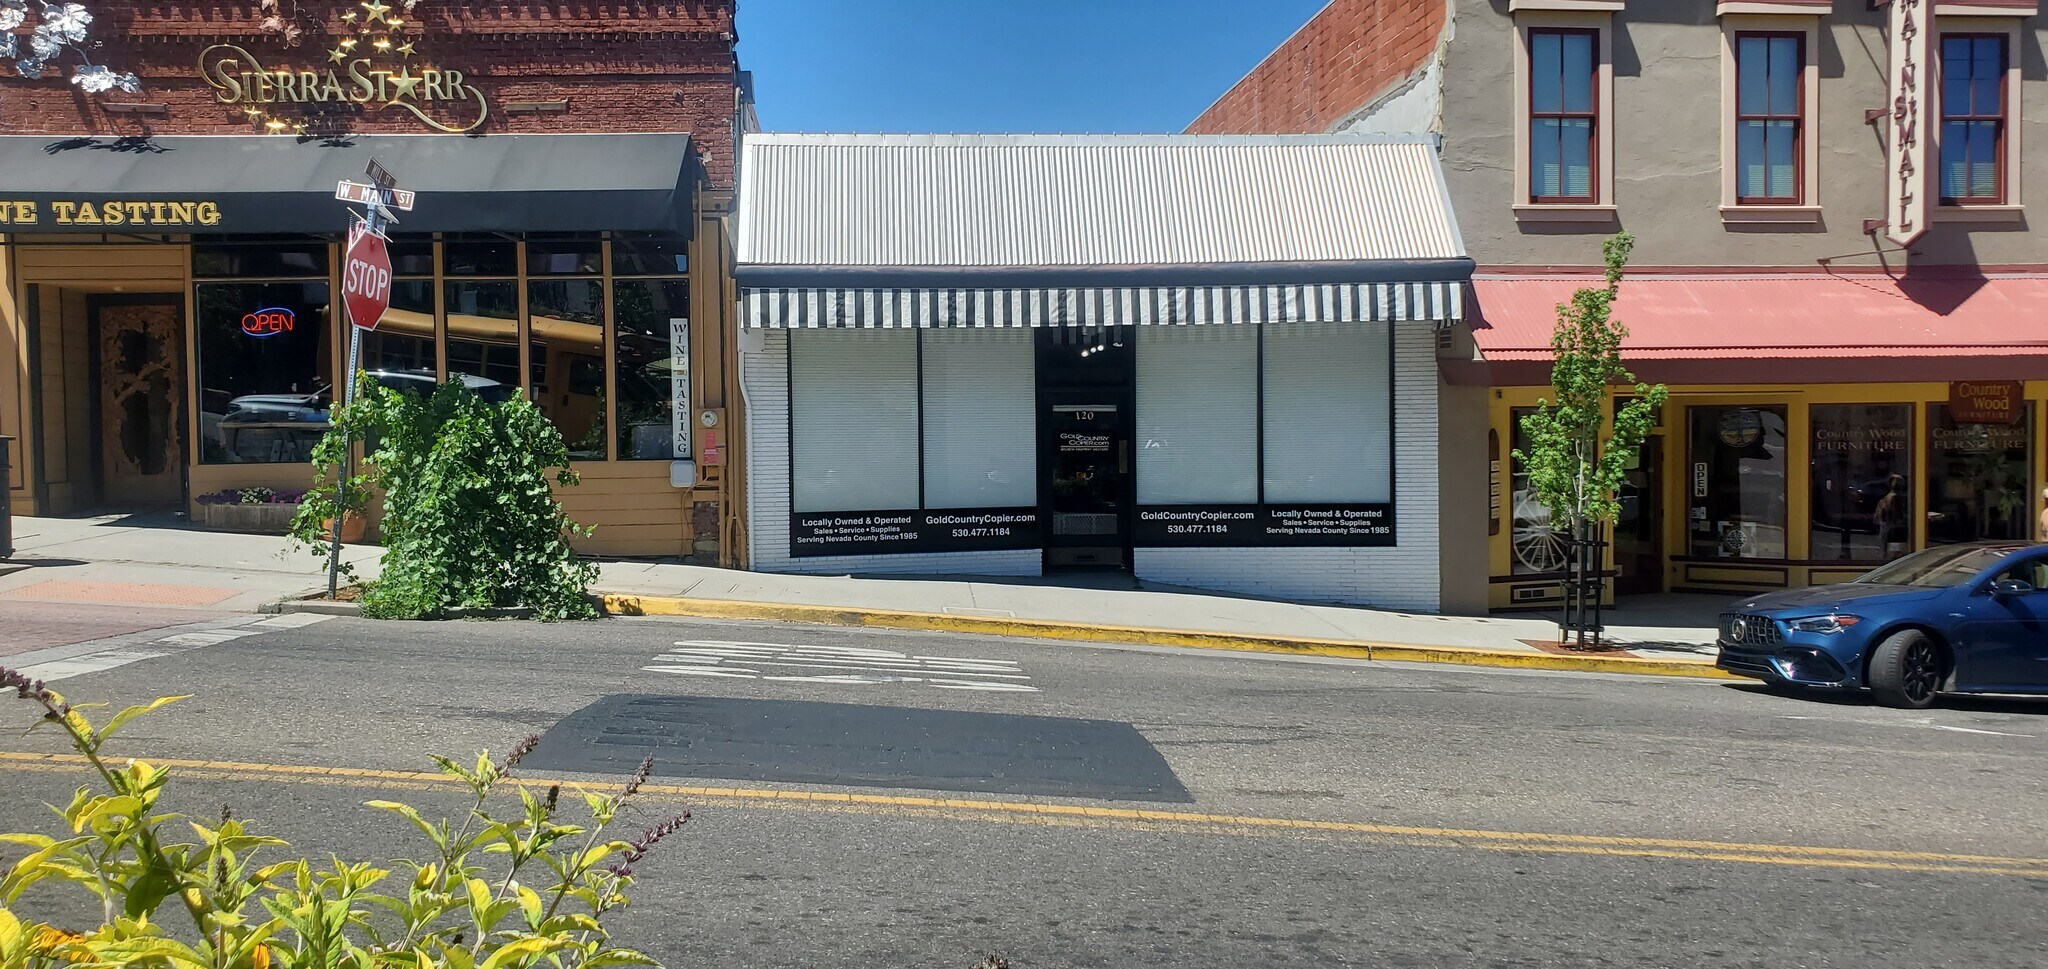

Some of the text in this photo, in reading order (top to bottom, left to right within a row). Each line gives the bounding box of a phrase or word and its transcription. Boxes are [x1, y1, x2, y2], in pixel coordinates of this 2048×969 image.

[1900, 0, 1917, 93] AIN
[1898, 119, 1916, 232] MALL
[360, 187, 392, 204] MAIN
[399, 193, 412, 205] ST
[52, 201, 221, 225] TASTING
[347, 258, 388, 300] STOP
[242, 314, 294, 331] OPEN
[673, 323, 688, 454] WINE TASTING
[1959, 383, 2010, 398] Country
[1973, 396, 2009, 410] Wood
[1076, 411, 1094, 420] 120
[1869, 428, 1906, 438] Wood
[1932, 427, 2025, 439] Coun Wood
[1817, 441, 1905, 450] FURNITURE
[1934, 440, 2024, 449] FURNURE
[1696, 463, 1705, 496] OPEN
[925, 514, 1036, 525] GoldCountryCopier.com
[1141, 511, 1254, 521] GoldCountryCopier.com
[1271, 510, 1302, 518] Locally
[1343, 510, 1382, 518] Operated
[802, 516, 912, 528] Locally Owned & Operated
[1340, 519, 1371, 527] Supplies
[952, 527, 1010, 537] 530.477.1184
[1167, 524, 1228, 533] 530.477.1184
[1266, 527, 1293, 535] Serving
[1322, 527, 1348, 535] County
[797, 532, 918, 544] Serving Nevada County Since 1985
[640, 641, 1040, 692] STOP
